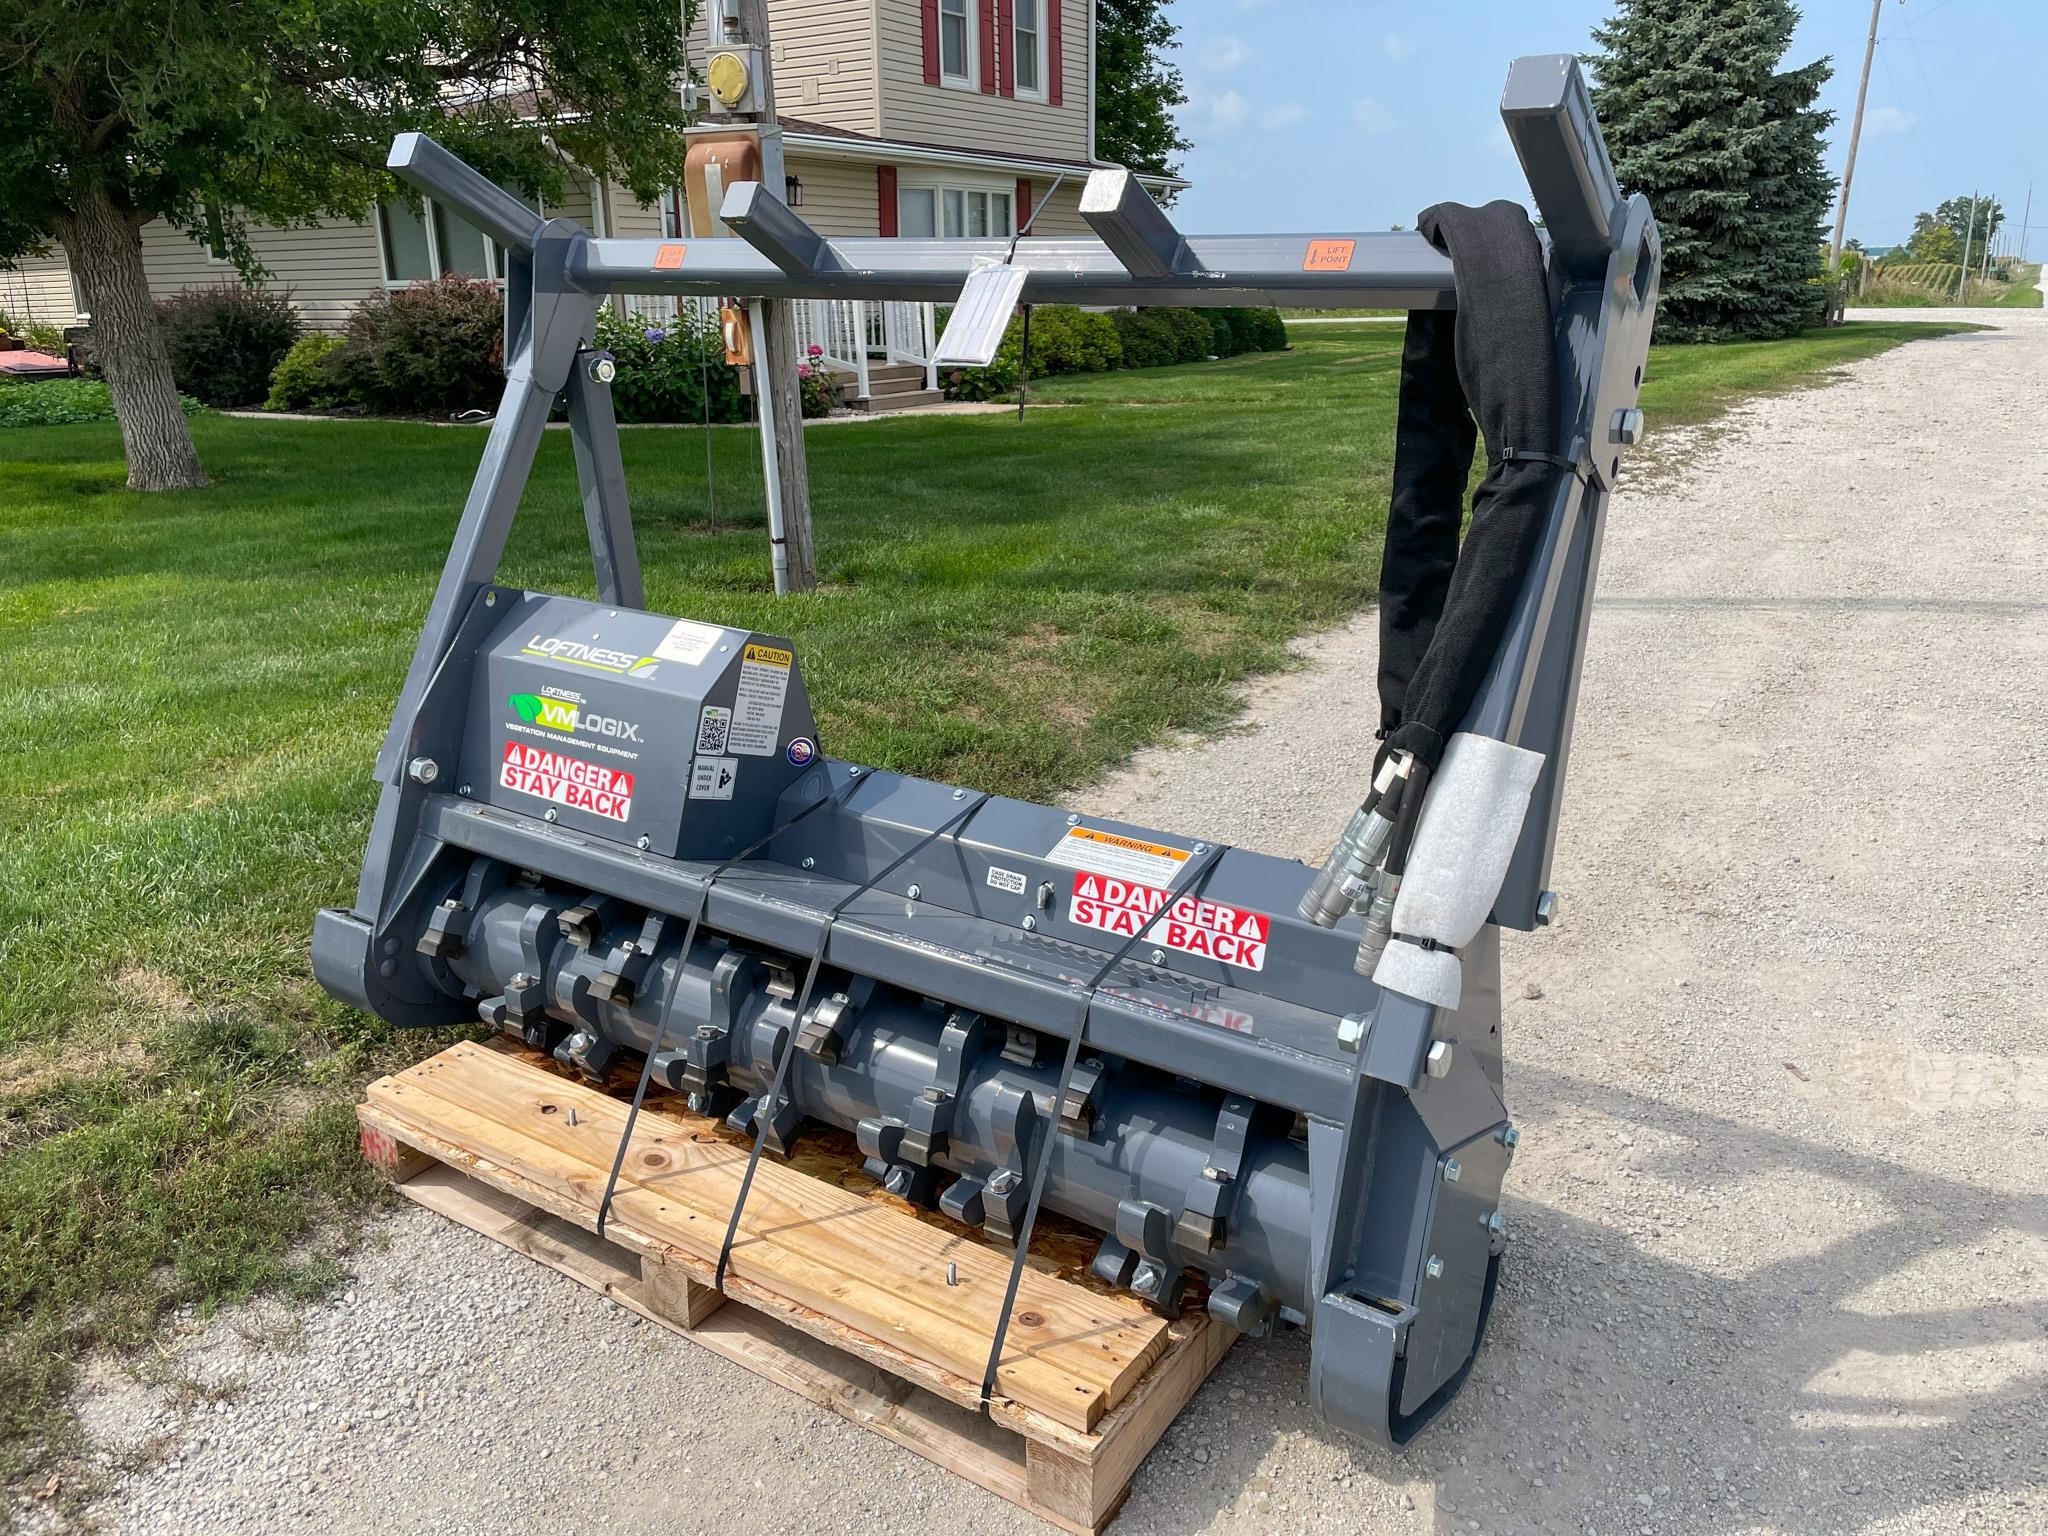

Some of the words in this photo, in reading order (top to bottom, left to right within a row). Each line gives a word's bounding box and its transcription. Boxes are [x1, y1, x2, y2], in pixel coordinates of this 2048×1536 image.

[1327, 246, 1346, 254] LIFT
[527, 634, 638, 669] LOFTNESS
[757, 648, 790, 662] CAUTION
[541, 685, 581, 700] LOFTNESS
[542, 703, 640, 742] VMLOGIX
[505, 722, 546, 738] VEGETATION
[546, 732, 596, 750] MANAGEMENT
[596, 744, 639, 760] EQUIPMENT
[523, 747, 613, 793] DANGER
[697, 764, 715, 772] MANUAL
[504, 766, 561, 799] STAY
[565, 783, 627, 819] BACK
[1104, 836, 1154, 853] WARNING
[991, 874, 1022, 886] PROTECTION
[1103, 879, 1236, 935] DANGER
[1166, 922, 1260, 969] BACK
